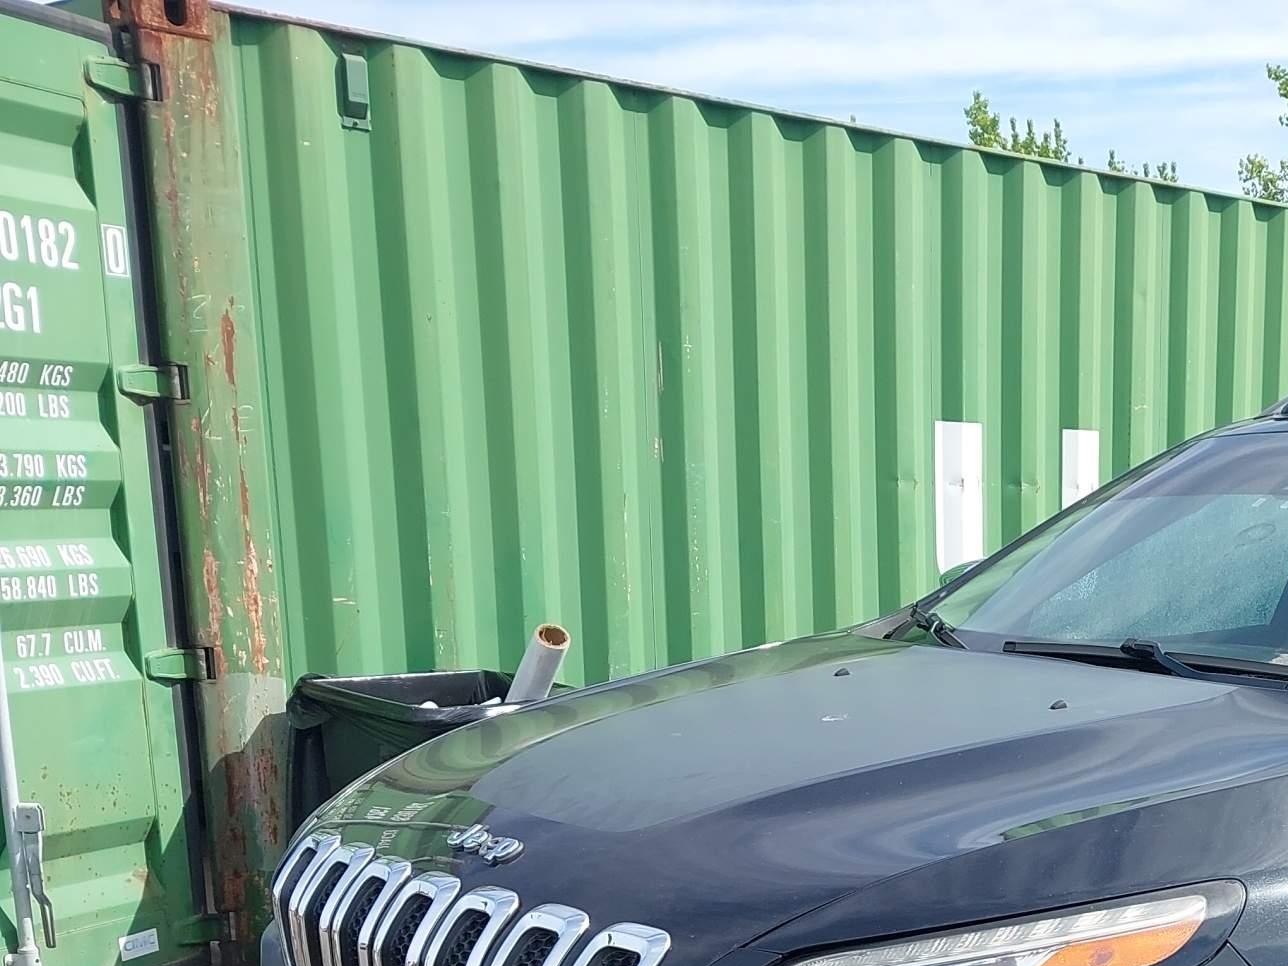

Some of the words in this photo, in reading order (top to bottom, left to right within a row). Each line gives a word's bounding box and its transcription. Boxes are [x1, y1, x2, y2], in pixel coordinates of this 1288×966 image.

[0, 210, 80, 270] 0182
[103, 225, 128, 275] 0
[0, 282, 41, 334] G1
[40, 364, 73, 387] KGS
[38, 393, 70, 418] LBS
[56, 454, 87, 478] KGS
[52, 485, 85, 506] LBS
[57, 543, 94, 567] KGS
[1, 575, 56, 600] 58.840
[68, 573, 99, 598] LBS
[16, 633, 51, 658] 67.7
[63, 629, 107, 653] CU.M.
[13, 663, 65, 689] 2.390
[447, 823, 525, 867] Jeep
